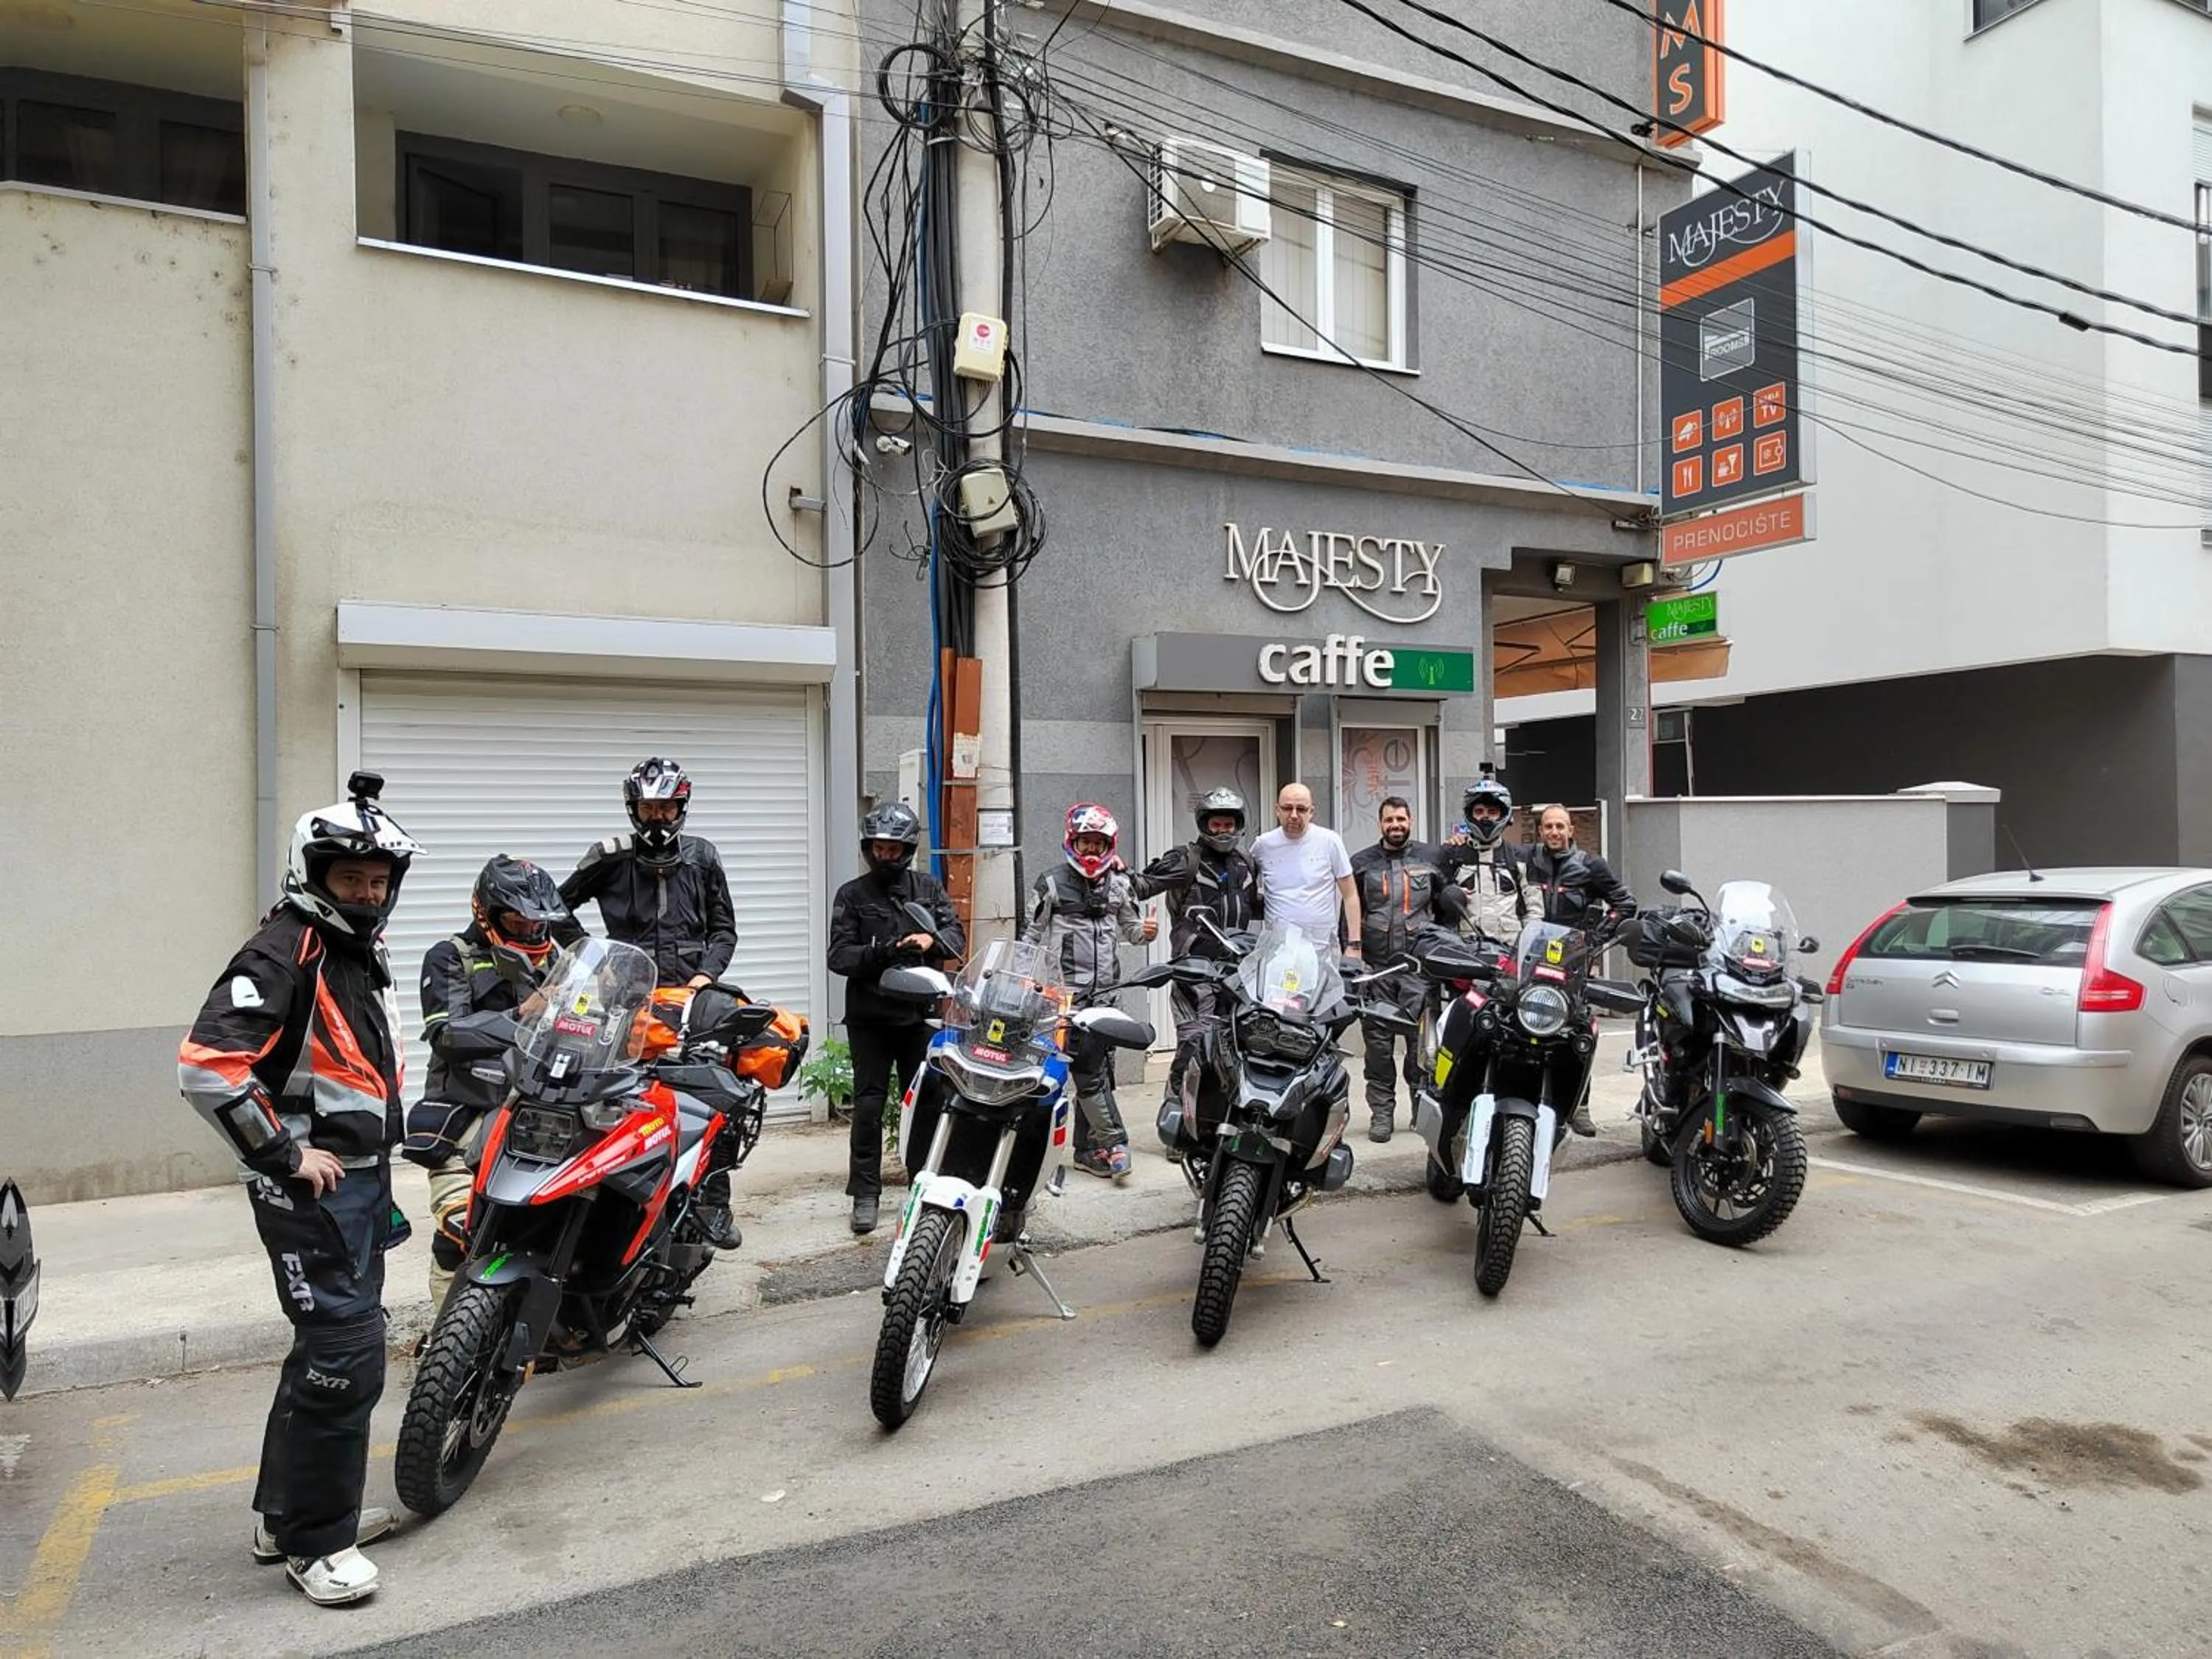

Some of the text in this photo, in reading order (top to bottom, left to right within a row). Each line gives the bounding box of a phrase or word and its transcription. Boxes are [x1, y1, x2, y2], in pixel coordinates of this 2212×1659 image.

[1668, 179, 1786, 267] MAJESTY
[1223, 522, 1446, 623] MAJESTY
[1667, 595, 1713, 621] MAJESTY
[1651, 622, 1688, 640] caffe
[1258, 633, 1395, 688] caffe
[557, 1019, 594, 1036] MOTUL
[974, 1047, 1007, 1062] MOTUL
[644, 1125, 672, 1151] MOTUL
[281, 1251, 316, 1312] FXR
[306, 1368, 351, 1390] FXR
